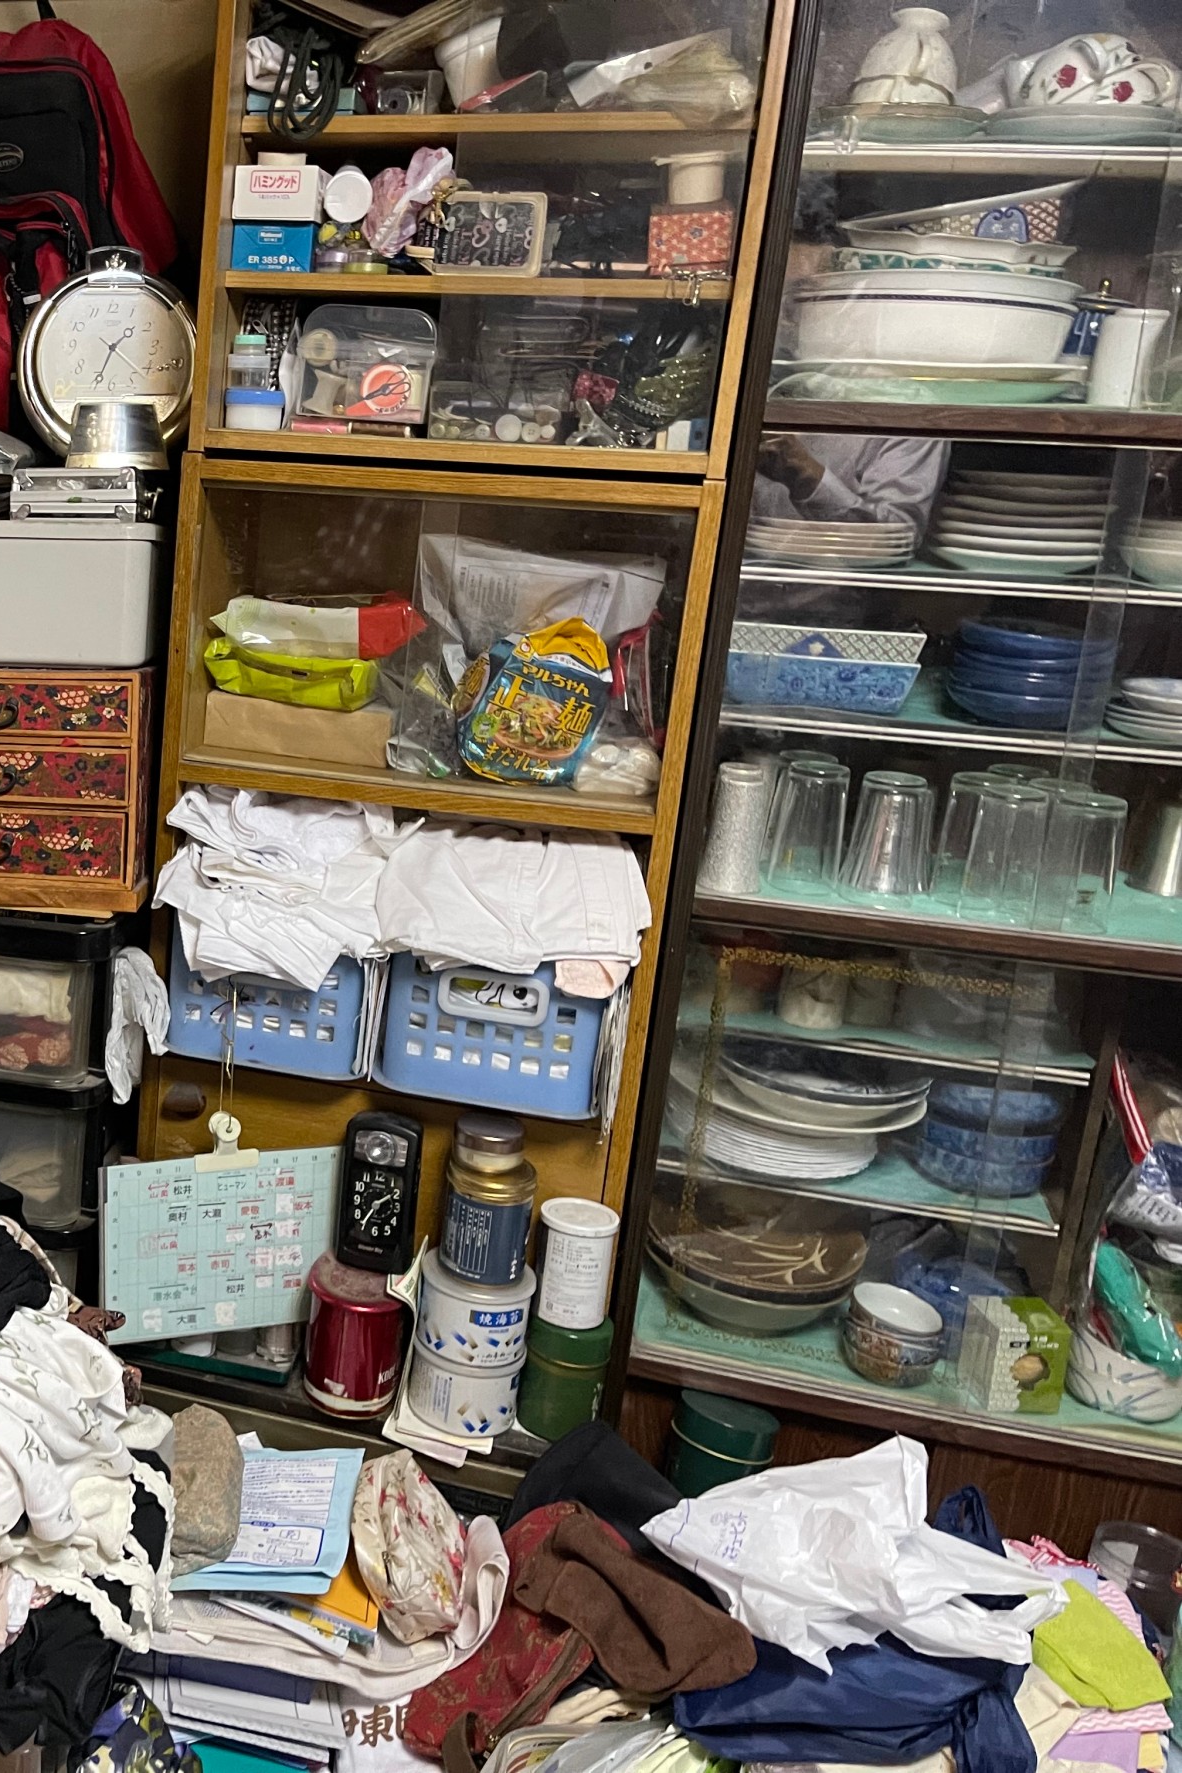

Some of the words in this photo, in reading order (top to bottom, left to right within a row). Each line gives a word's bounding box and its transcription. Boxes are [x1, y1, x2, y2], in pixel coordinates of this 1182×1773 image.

[247, 255, 260, 264] ER
[261, 255, 278, 265] 385
[89, 306, 99, 318] 11
[106, 299, 120, 314] 12
[130, 303, 137, 318] 1
[71, 321, 86, 332] 10
[141, 321, 153, 333] 2
[68, 338, 77, 356] 9
[148, 339, 160, 356] 3
[73, 359, 85, 375] 8
[141, 359, 153, 376] 4
[107, 374, 116, 391] 6
[127, 371, 138, 387] 5
[522, 661, 590, 697] マルちゃん
[362, 1171, 370, 1182] 11
[374, 1170, 386, 1182] 12
[390, 1176, 395, 1187] 1
[354, 1180, 365, 1192] 10
[353, 1194, 361, 1206] 9
[393, 1188, 400, 1200] 2
[393, 1202, 401, 1213] 3
[354, 1208, 361, 1220] 8
[390, 1216, 397, 1227] 4
[371, 1226, 378, 1237] 6
[383, 1225, 391, 1236] 5
[479, 1312, 520, 1327] 焼海苔
